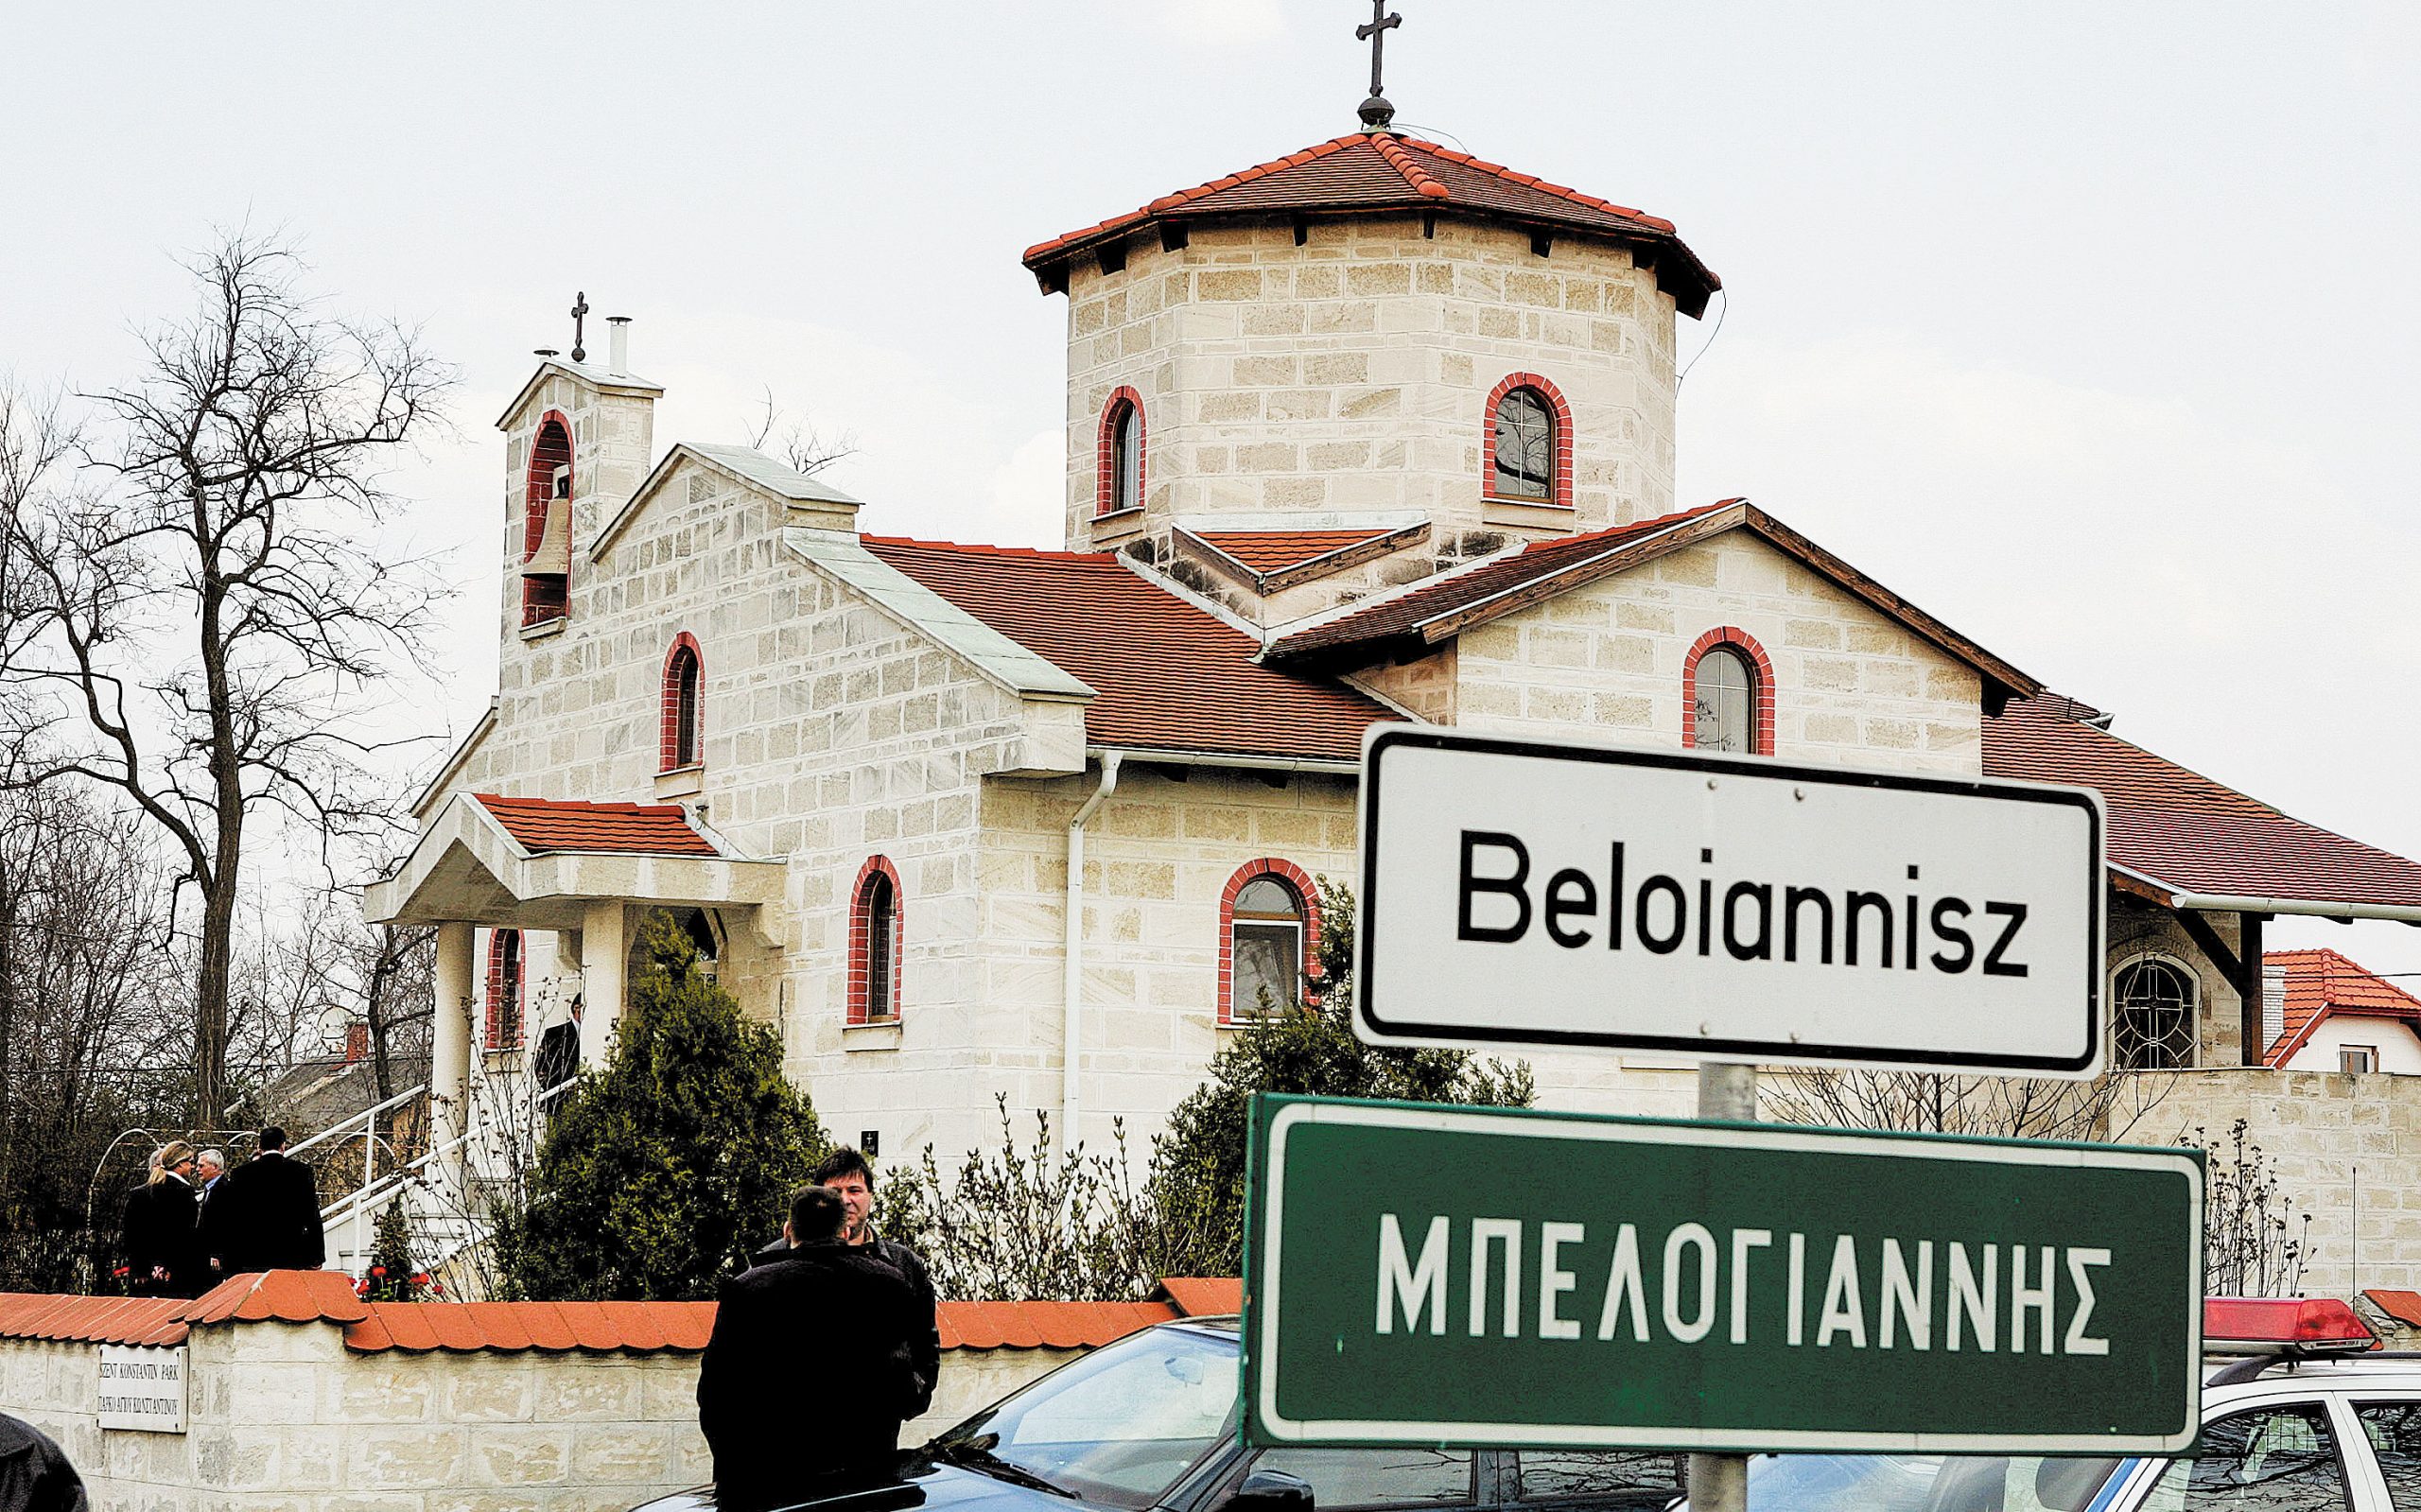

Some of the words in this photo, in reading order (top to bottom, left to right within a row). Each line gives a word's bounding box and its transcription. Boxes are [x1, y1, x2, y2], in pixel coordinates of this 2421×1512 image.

[1457, 829, 2029, 978] Beloiannisz
[1376, 1213, 2113, 1356] ΜΠΕΛΟΓΙΑΝΝΗΣ
[99, 1364, 117, 1378] SZENT
[119, 1364, 158, 1380] KONSTANTIN
[162, 1364, 179, 1380] PARK
